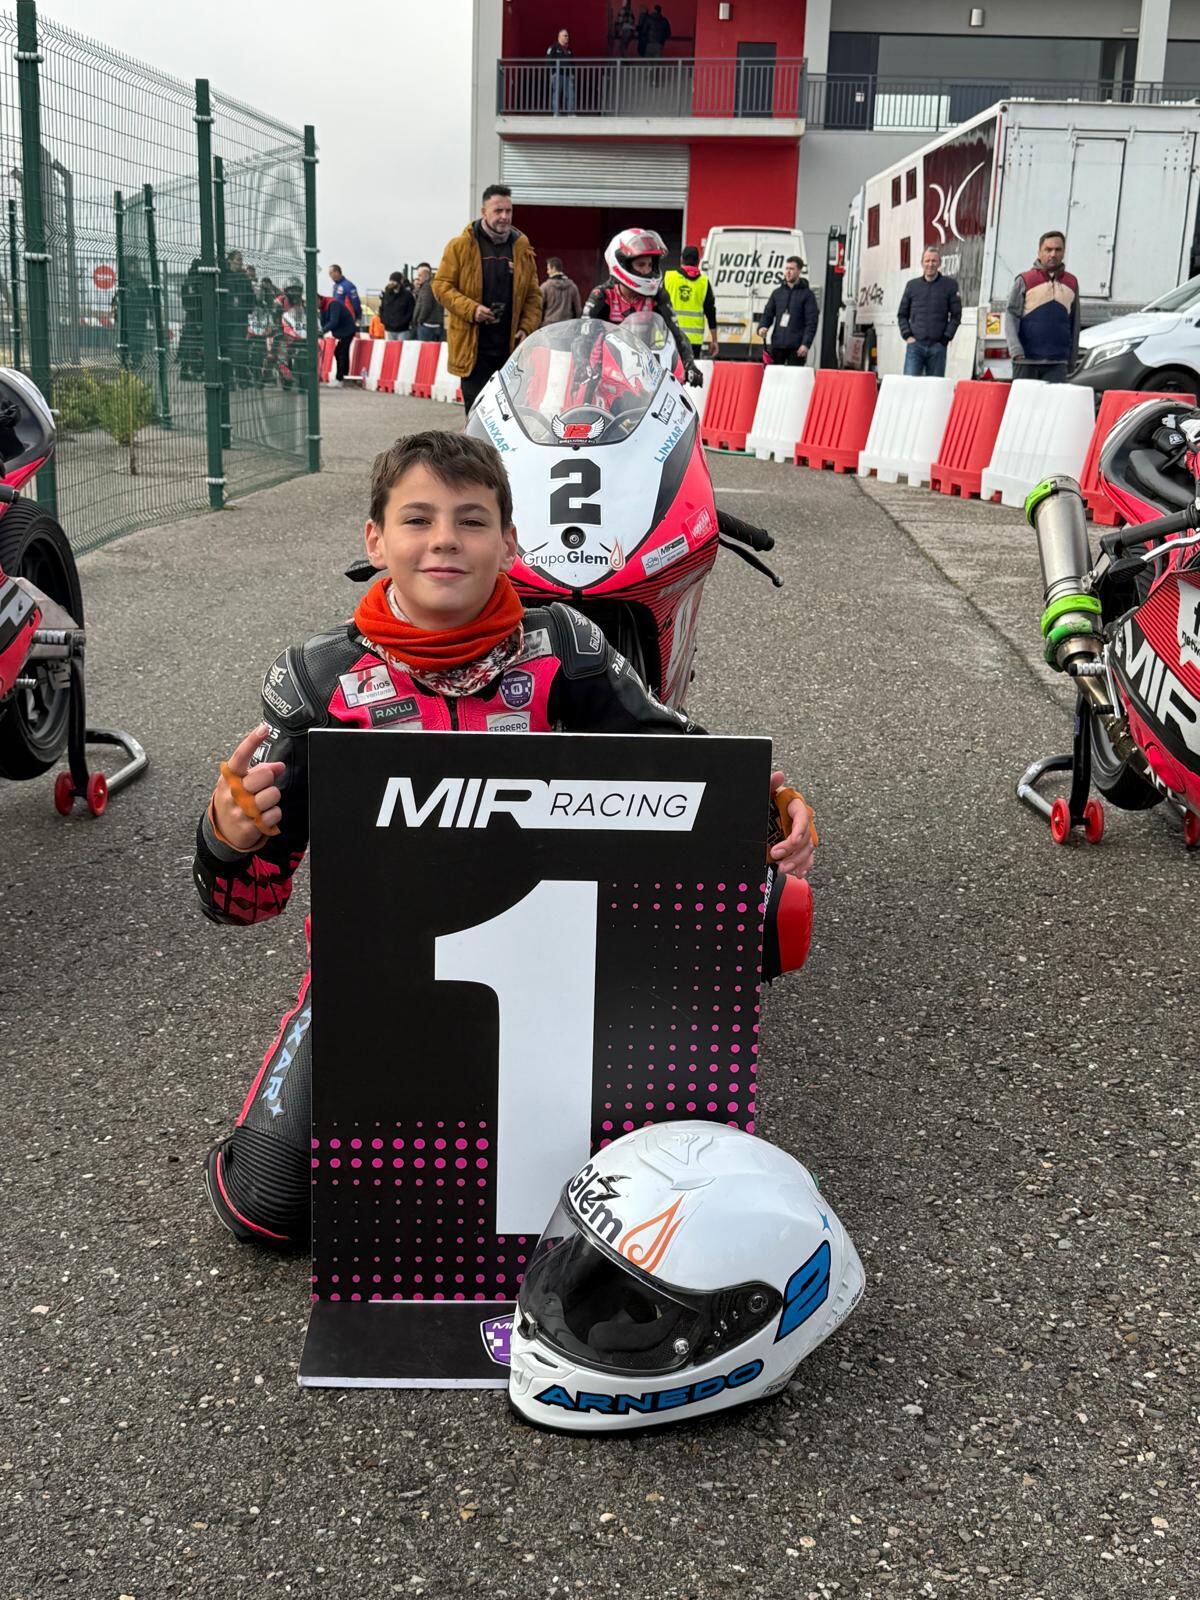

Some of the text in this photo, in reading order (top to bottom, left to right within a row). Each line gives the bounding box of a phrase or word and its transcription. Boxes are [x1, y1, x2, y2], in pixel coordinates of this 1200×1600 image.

[715, 269, 784, 288] progres
[719, 250, 785, 269] work in
[484, 417, 510, 453] LINXAR
[654, 425, 683, 463] LINXAR
[550, 458, 602, 525] 2
[375, 703, 413, 719] RAYLU
[376, 777, 688, 829] MIR RACING
[434, 880, 598, 1236] 1
[571, 1163, 623, 1244] Glem
[774, 1239, 832, 1344] 2
[533, 1358, 765, 1415] ARNEDO
